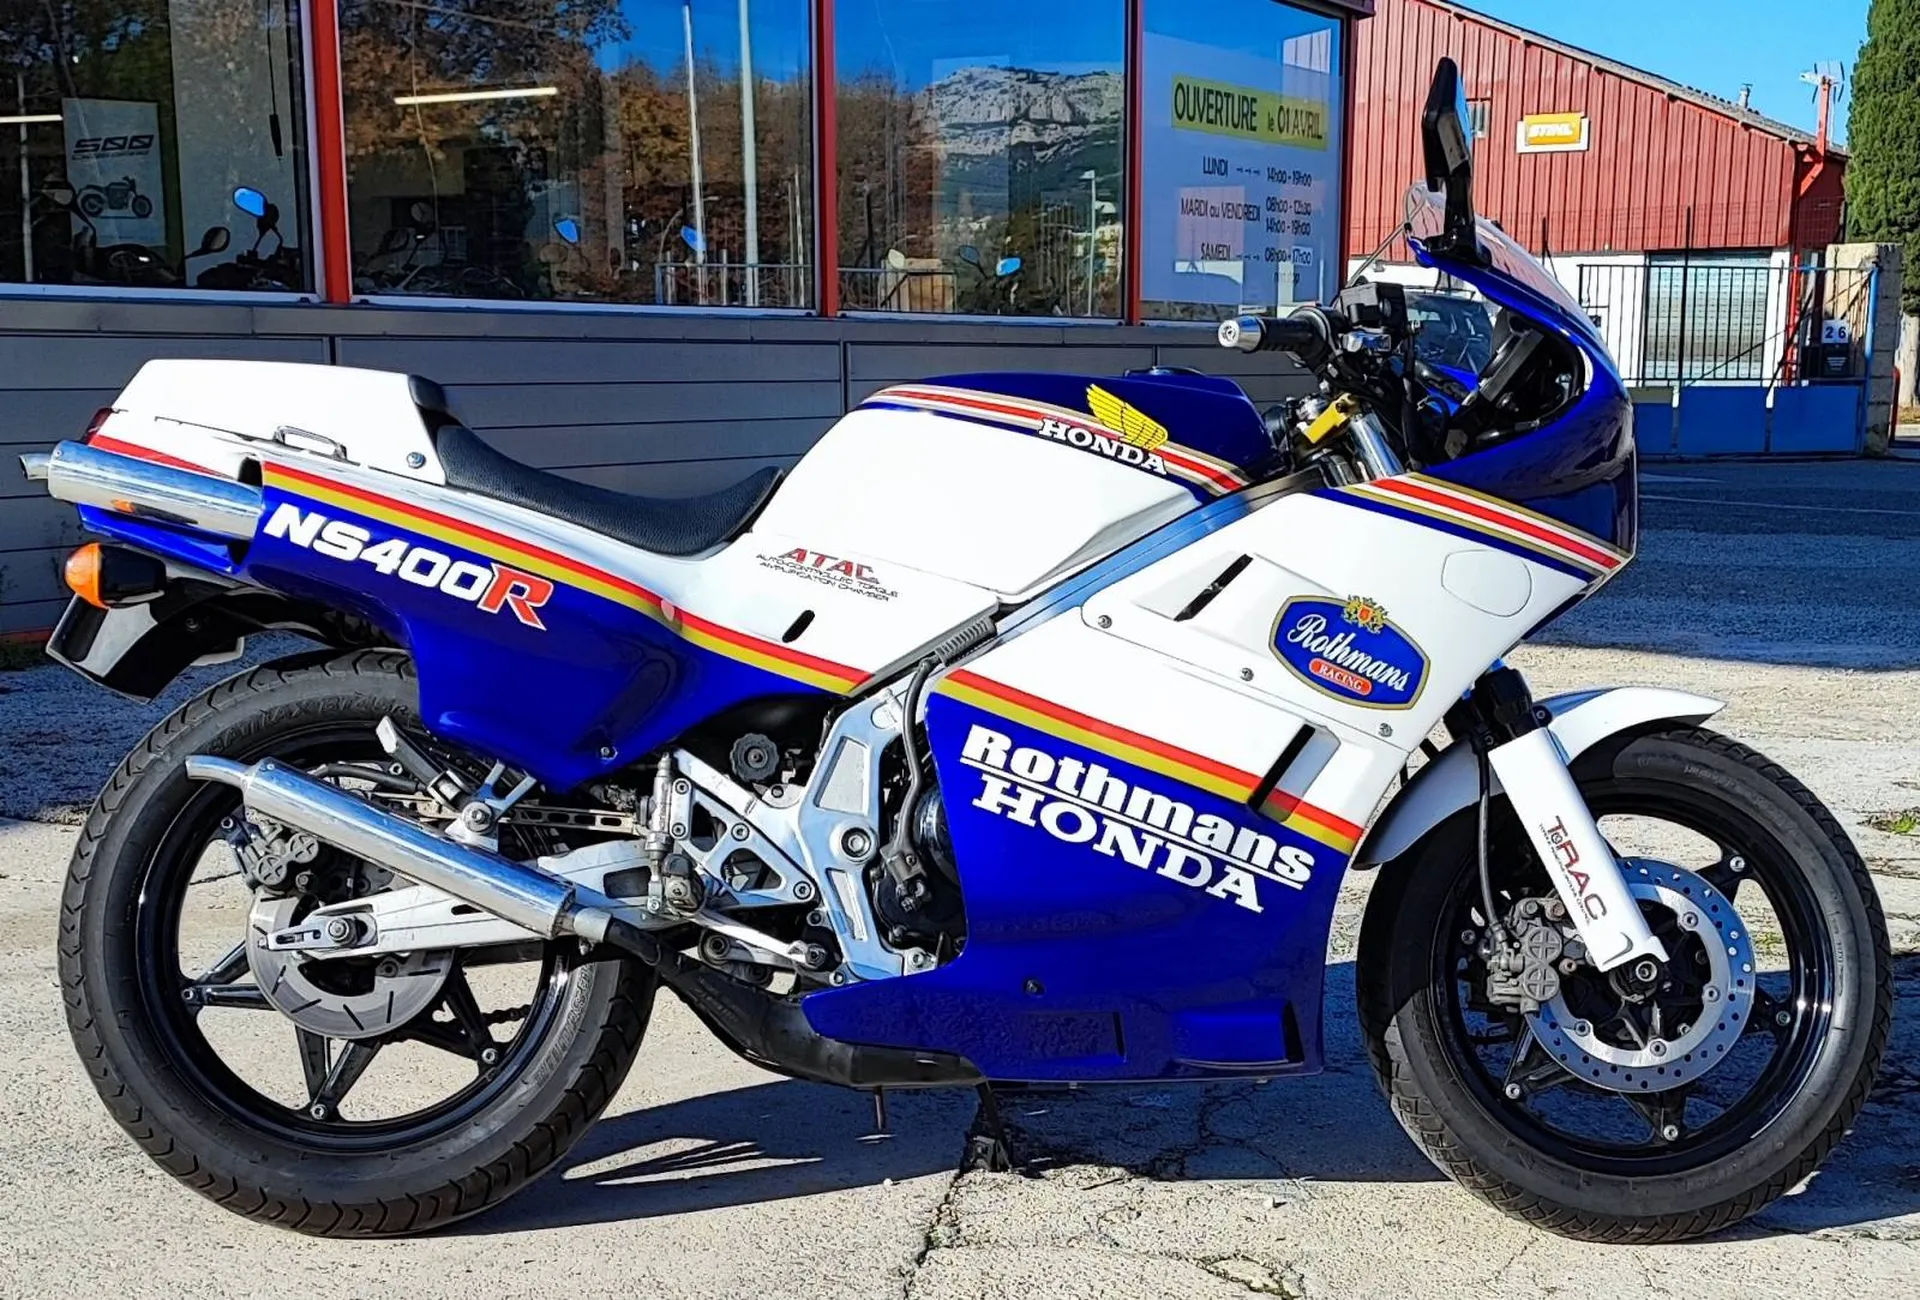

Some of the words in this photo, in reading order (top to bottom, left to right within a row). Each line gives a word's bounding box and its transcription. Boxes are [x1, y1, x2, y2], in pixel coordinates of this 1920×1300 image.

[1174, 82, 1258, 132] OUVERTURE
[1292, 108, 1323, 139] AVRIL
[1202, 155, 1229, 177] LUNDI
[1181, 198, 1208, 217] MARDI
[1220, 202, 1261, 222] VENDREDI
[1200, 243, 1231, 261] SAMEDI
[1038, 418, 1168, 476] HONDA
[263, 502, 554, 631] NS400R
[777, 548, 880, 585] ATAC
[1287, 614, 1411, 692] Rothmans
[1318, 663, 1363, 691] RACING
[960, 724, 1315, 883] Rothmans
[972, 772, 1264, 913] HONDA
